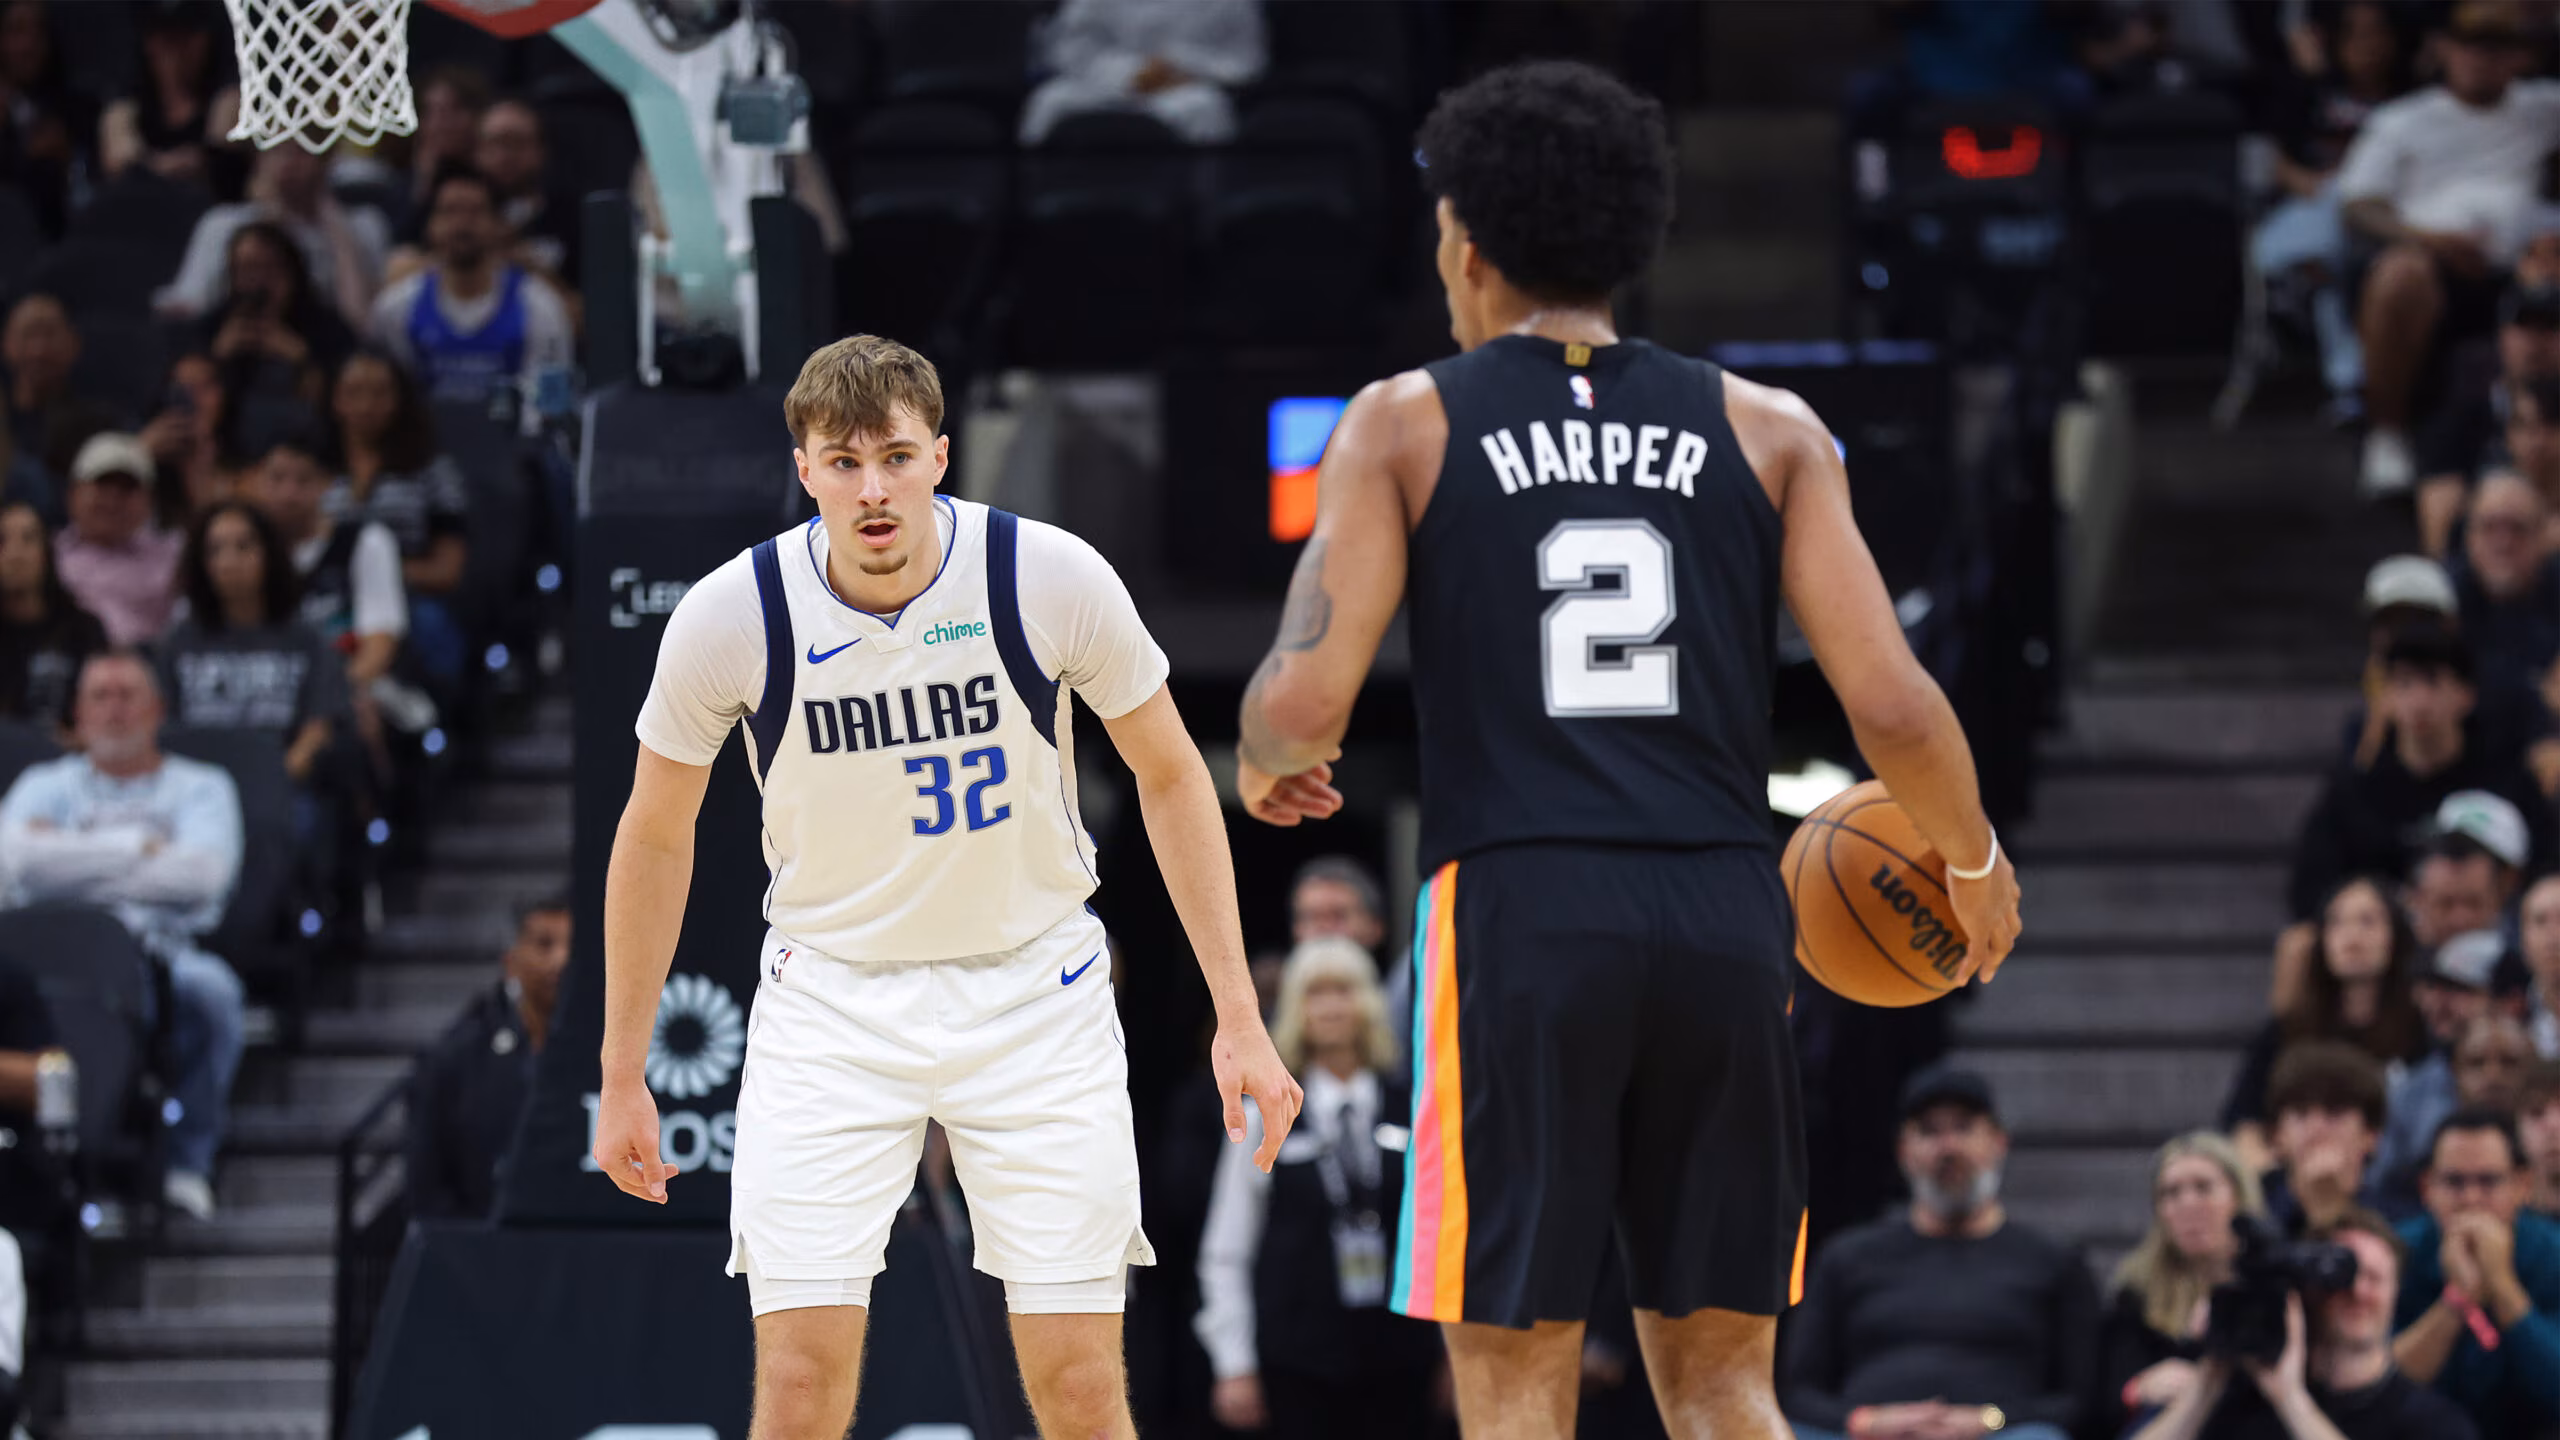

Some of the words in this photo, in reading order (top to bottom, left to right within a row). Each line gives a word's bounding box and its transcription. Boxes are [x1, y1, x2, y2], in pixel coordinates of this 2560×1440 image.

[1480, 418, 1708, 498] HARPER
[923, 620, 987, 646] chime
[1536, 518, 1679, 718] 2
[802, 672, 1000, 755] DALLAS
[902, 743, 1012, 837] 32
[1870, 863, 1968, 981] Wilson
